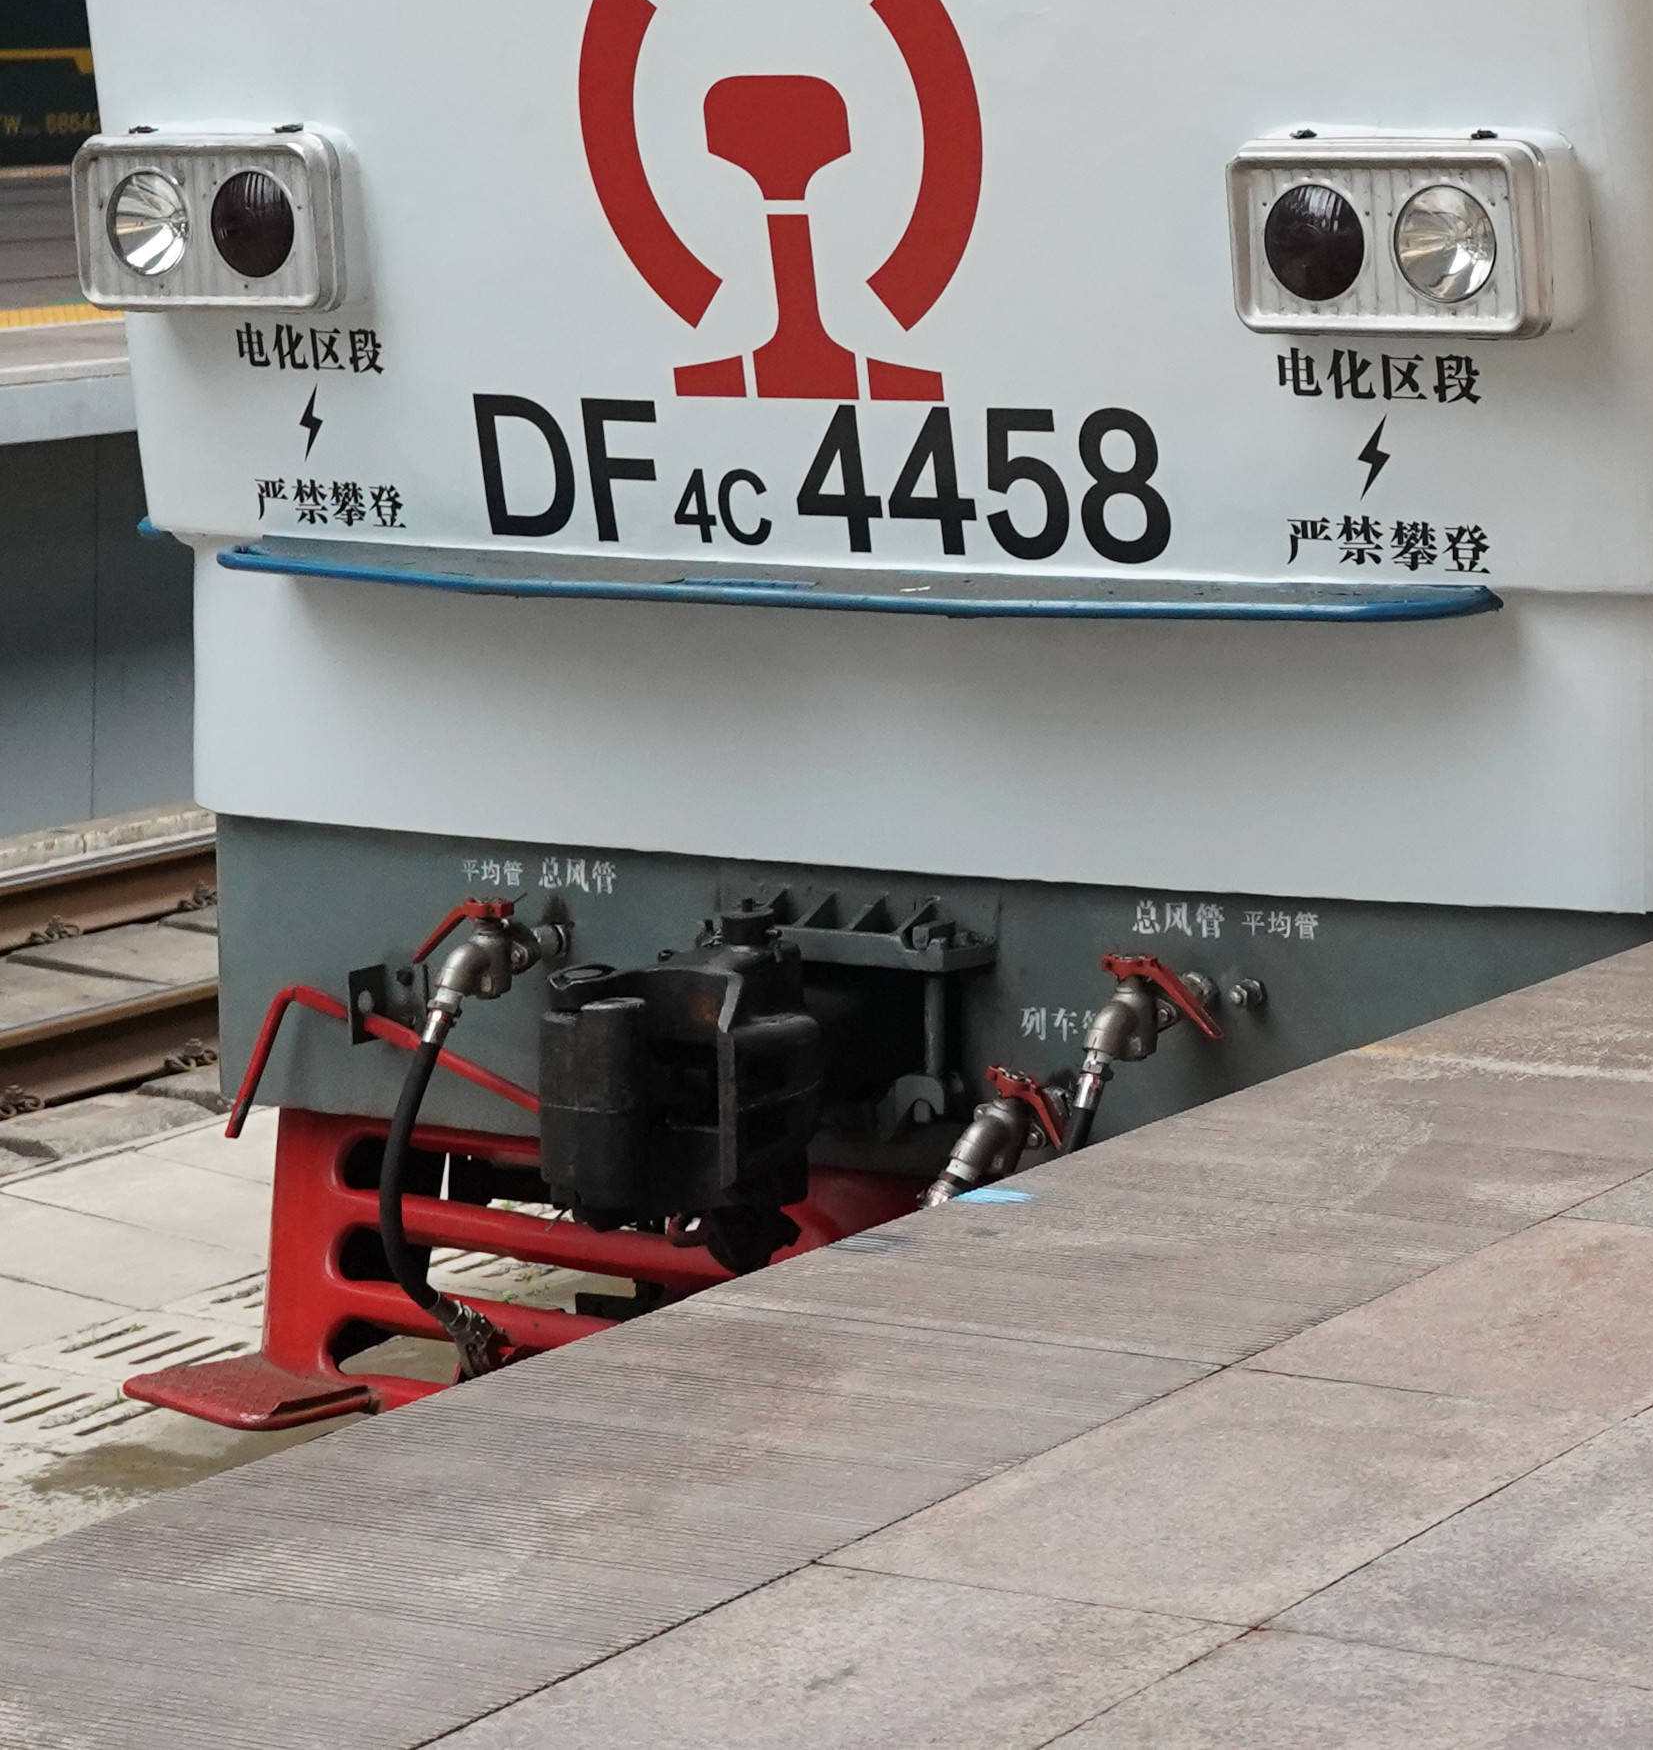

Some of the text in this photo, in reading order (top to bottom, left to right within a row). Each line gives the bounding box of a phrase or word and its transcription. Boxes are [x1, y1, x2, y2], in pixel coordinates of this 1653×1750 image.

[236, 322, 385, 375] 电化区段
[1277, 347, 1482, 404] 电化区段
[254, 477, 408, 529] 严禁攀登
[1287, 514, 1492, 575] 严禁攀登
[461, 855, 617, 895] 平均管 总风管
[1132, 899, 1319, 940] 总风管 平均管
